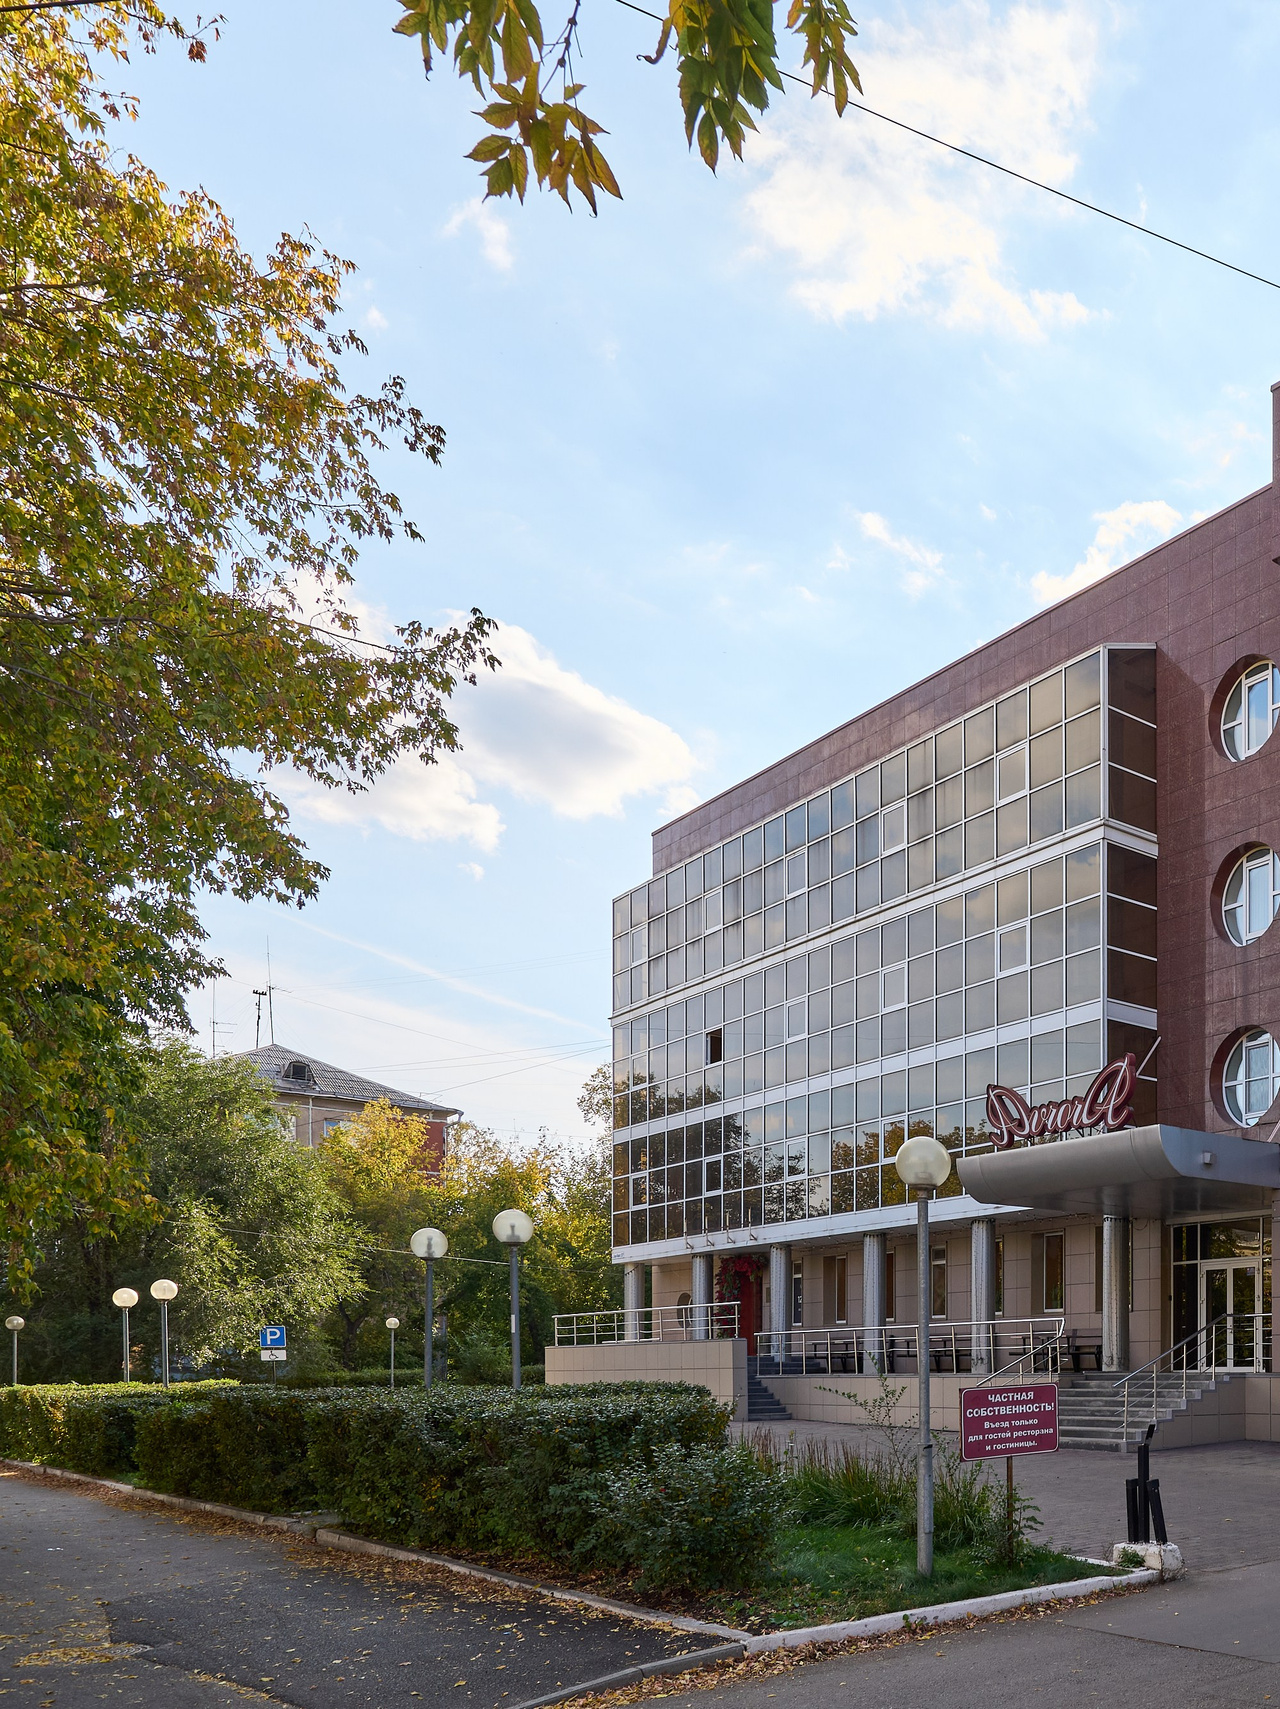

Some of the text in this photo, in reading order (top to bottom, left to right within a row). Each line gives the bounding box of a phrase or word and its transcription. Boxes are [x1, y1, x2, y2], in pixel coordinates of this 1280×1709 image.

[266, 1328, 281, 1345] P
[988, 1391, 1034, 1403] ЧАСТНАЯ
[966, 1402, 1055, 1418] СОБСТВЕННОСТЬ!
[984, 1418, 1038, 1429] Въезд только
[968, 1427, 1054, 1442] для гостей ресторана
[993, 1440, 1038, 1450] гостиницы.
